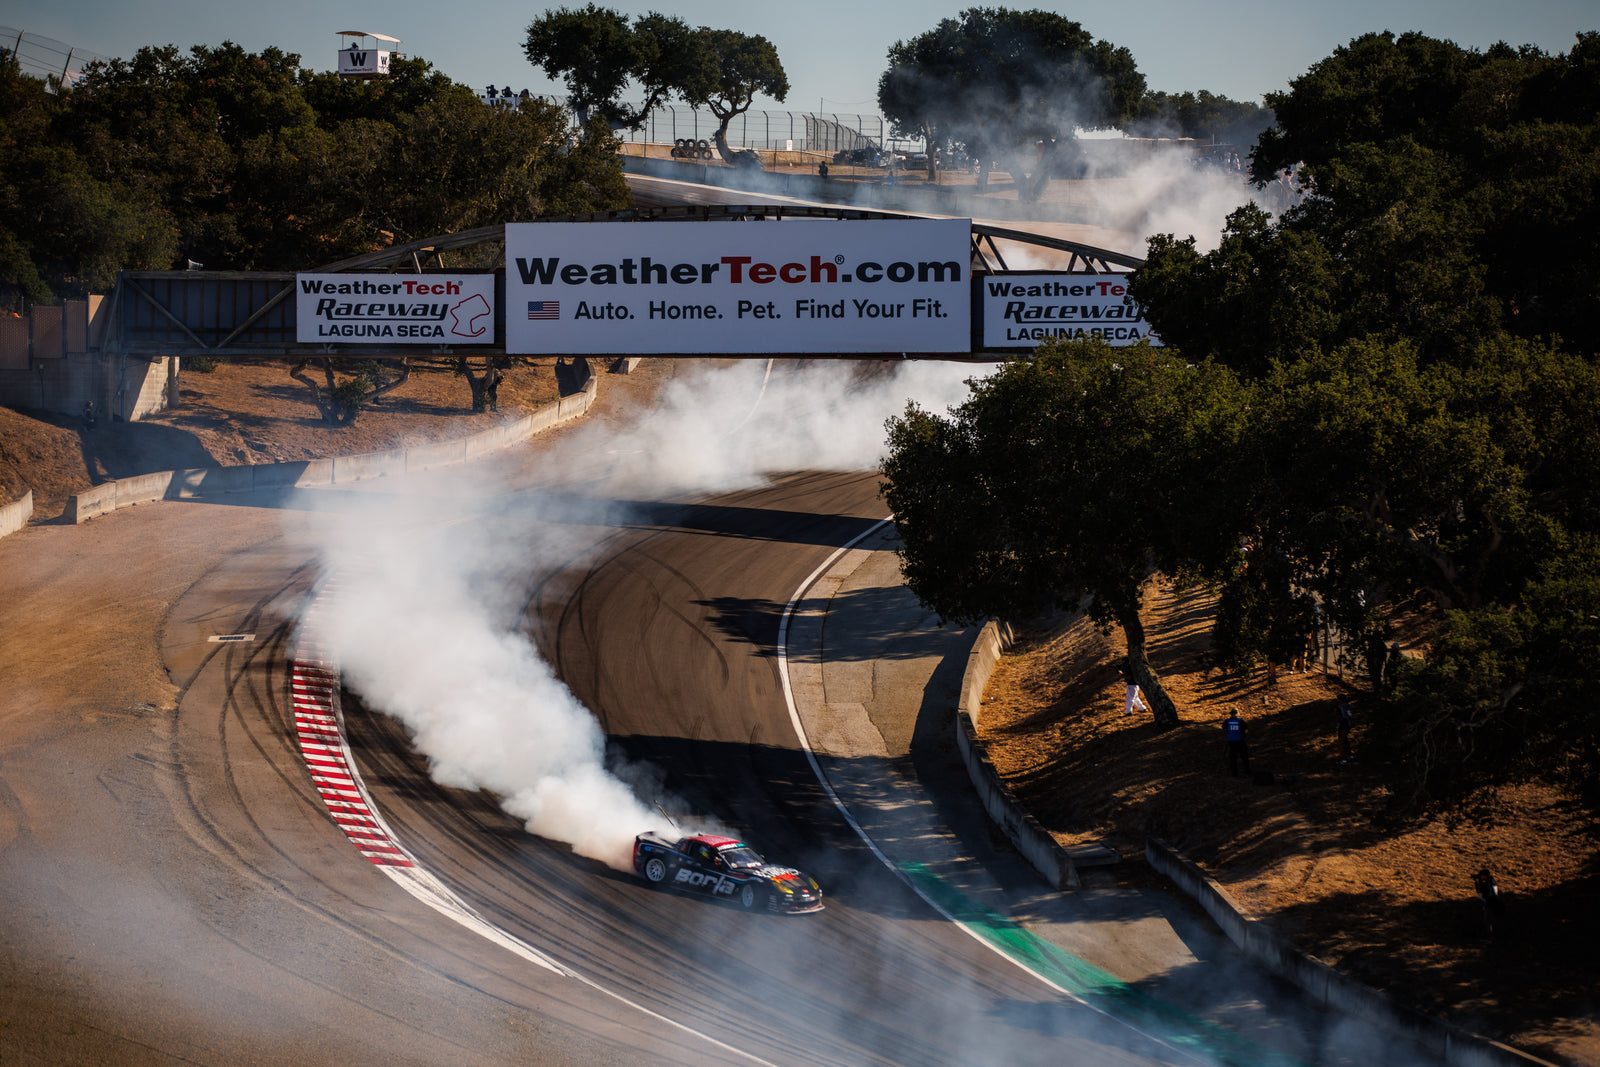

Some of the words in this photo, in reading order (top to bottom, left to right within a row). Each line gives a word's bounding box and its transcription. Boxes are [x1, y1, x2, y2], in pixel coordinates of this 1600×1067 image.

[349, 52, 367, 66] W
[316, 298, 449, 321] Raceway
[574, 300, 634, 320] Auto.
[649, 300, 723, 320] Home.
[737, 300, 781, 319] Pet.
[796, 298, 845, 319] Find
[853, 299, 904, 319] Your
[913, 298, 948, 318] Fit.
[1004, 301, 1144, 323] Raceway
[318, 324, 393, 337] LAGUNA
[397, 324, 445, 337] SECA
